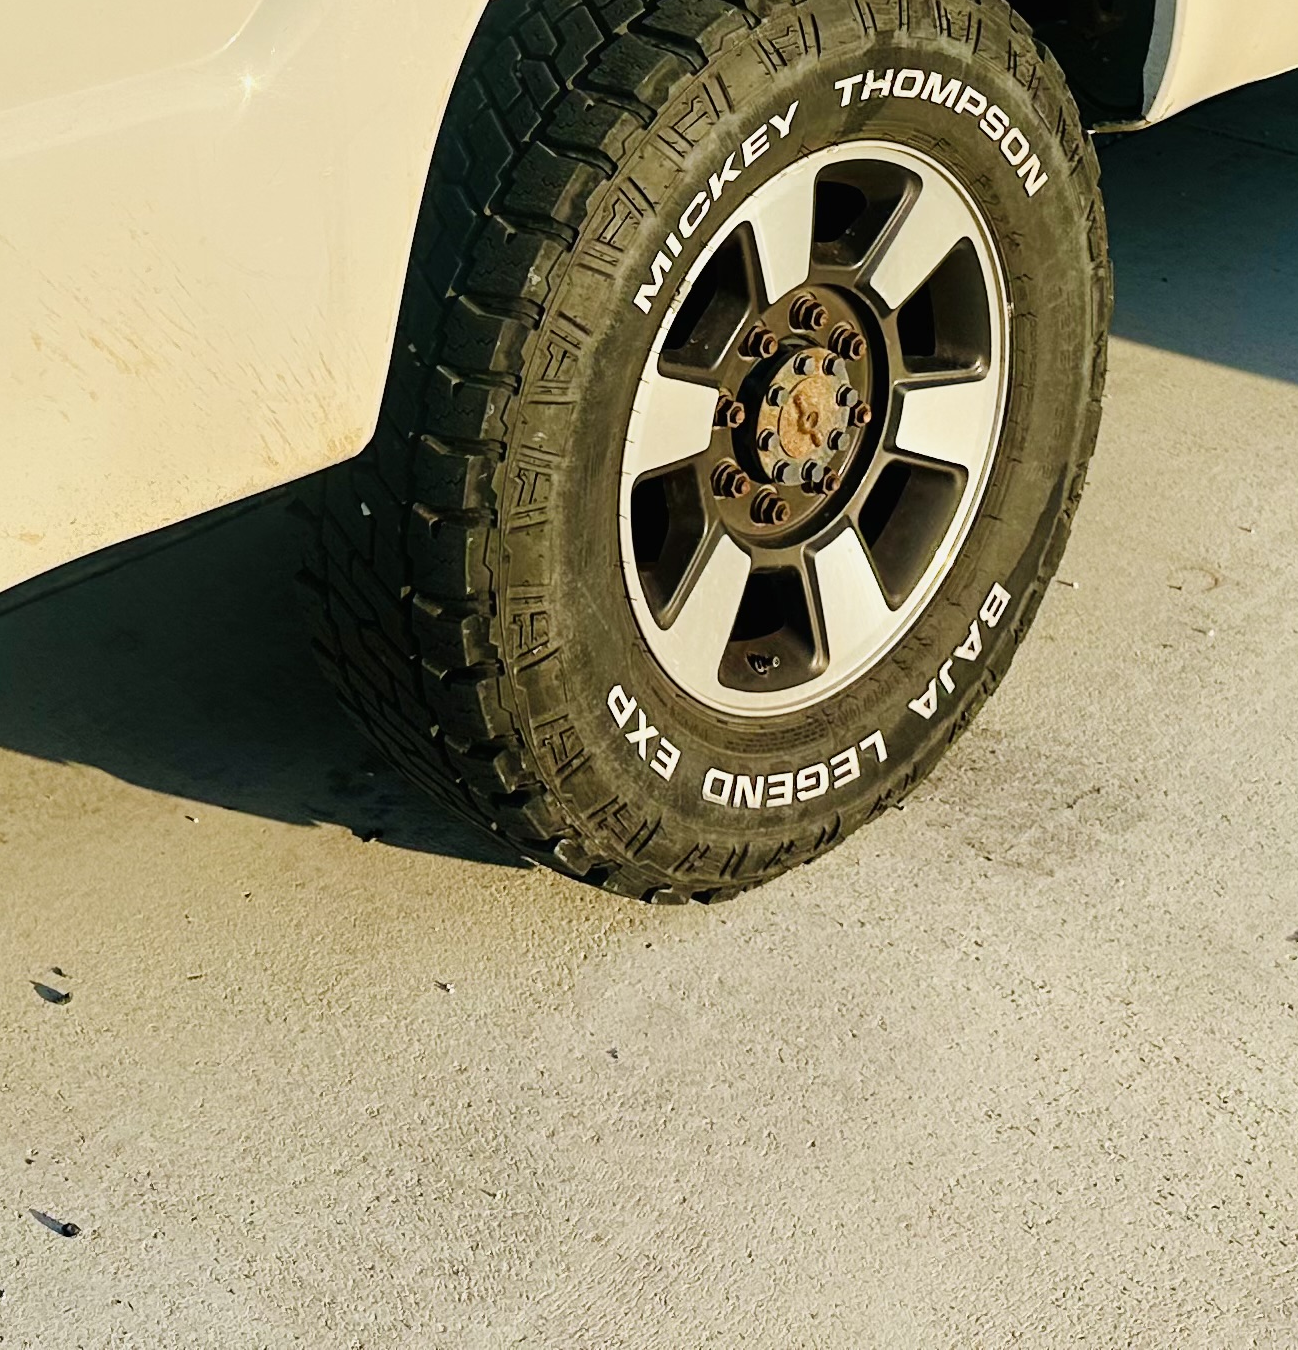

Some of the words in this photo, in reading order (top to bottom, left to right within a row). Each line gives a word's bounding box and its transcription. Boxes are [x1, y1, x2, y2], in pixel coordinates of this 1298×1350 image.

[633, 100, 799, 315] MICKEY
[834, 68, 1048, 197] THOMPSON
[907, 581, 1012, 720] BAJA
[606, 684, 681, 782] EXP
[701, 729, 888, 809] LEGEND
